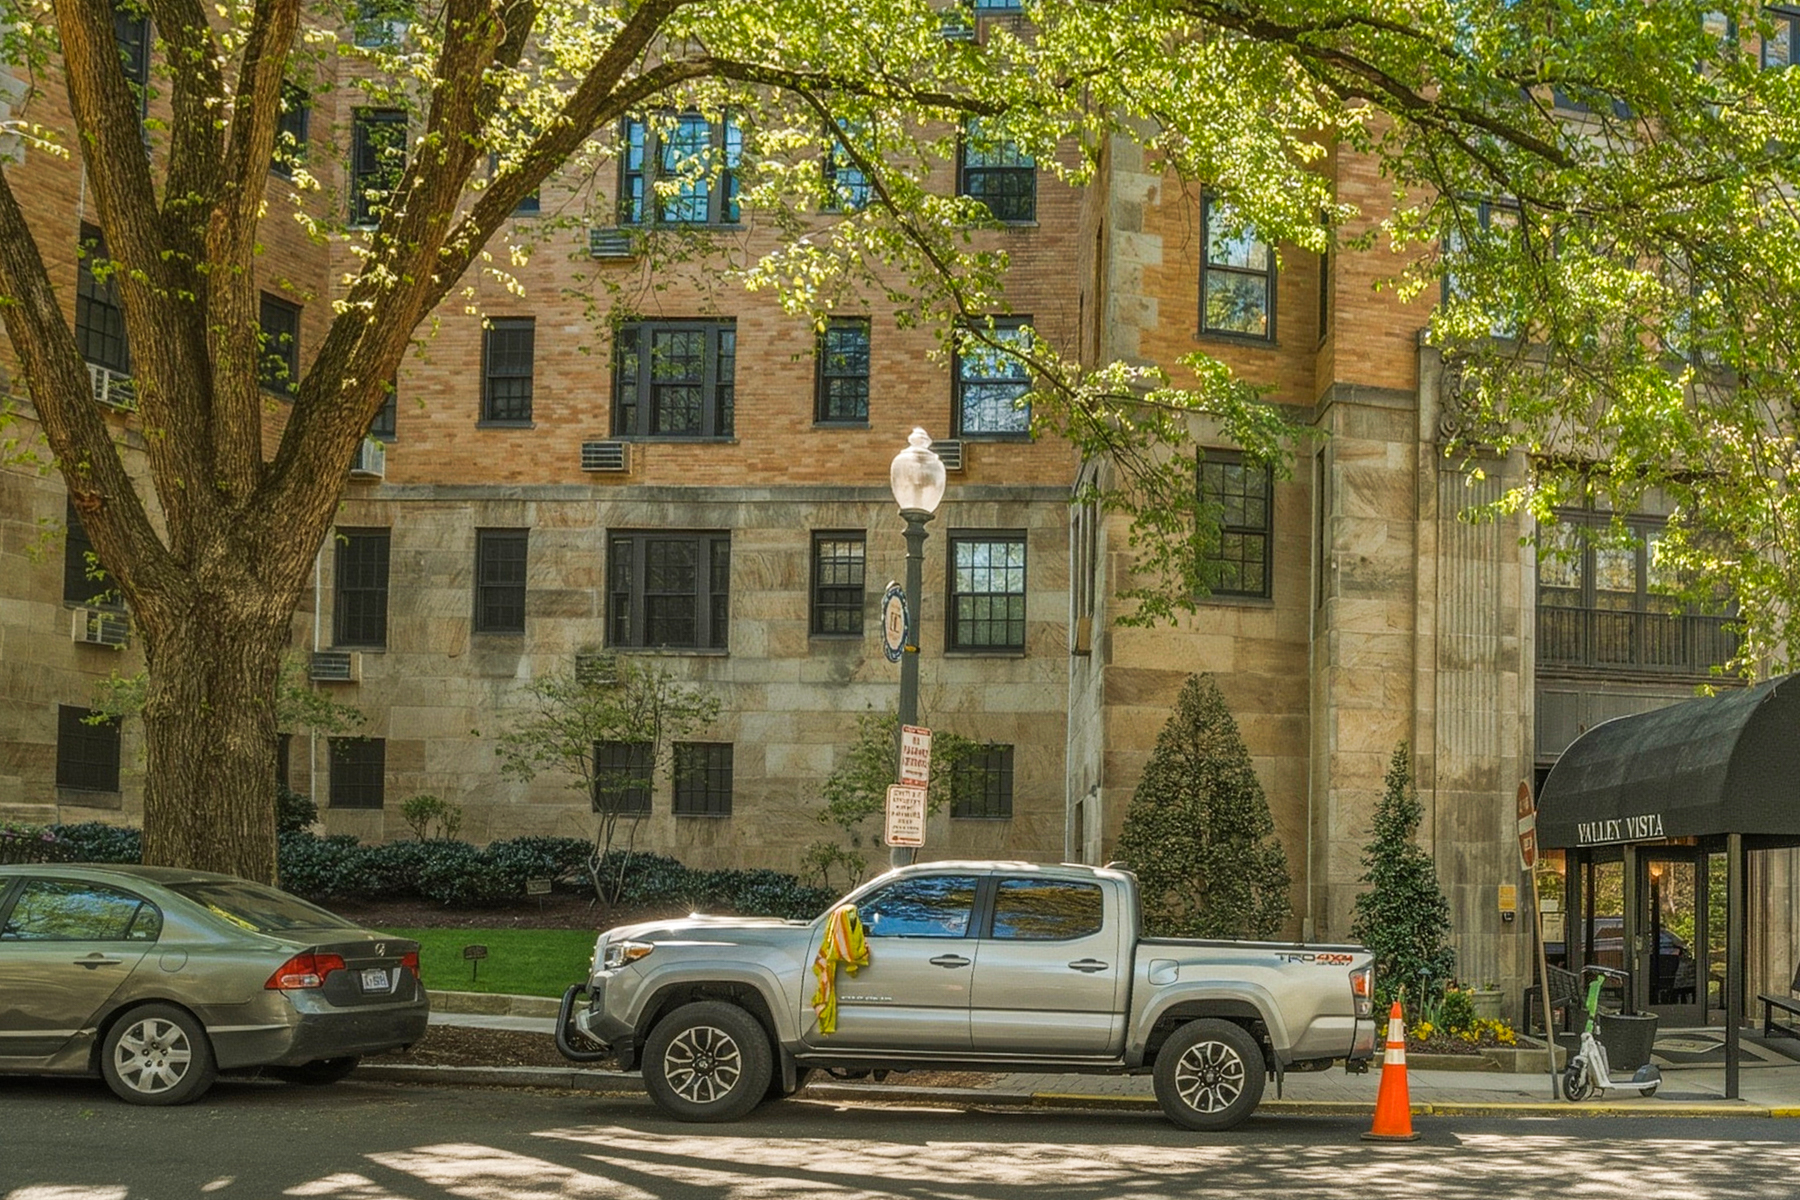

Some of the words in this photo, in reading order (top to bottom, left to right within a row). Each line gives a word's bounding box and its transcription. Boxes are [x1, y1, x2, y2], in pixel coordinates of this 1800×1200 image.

[1578, 819, 1621, 843] VALLEY
[1626, 814, 1664, 838] VISTA
[1275, 952, 1316, 964] TRD
